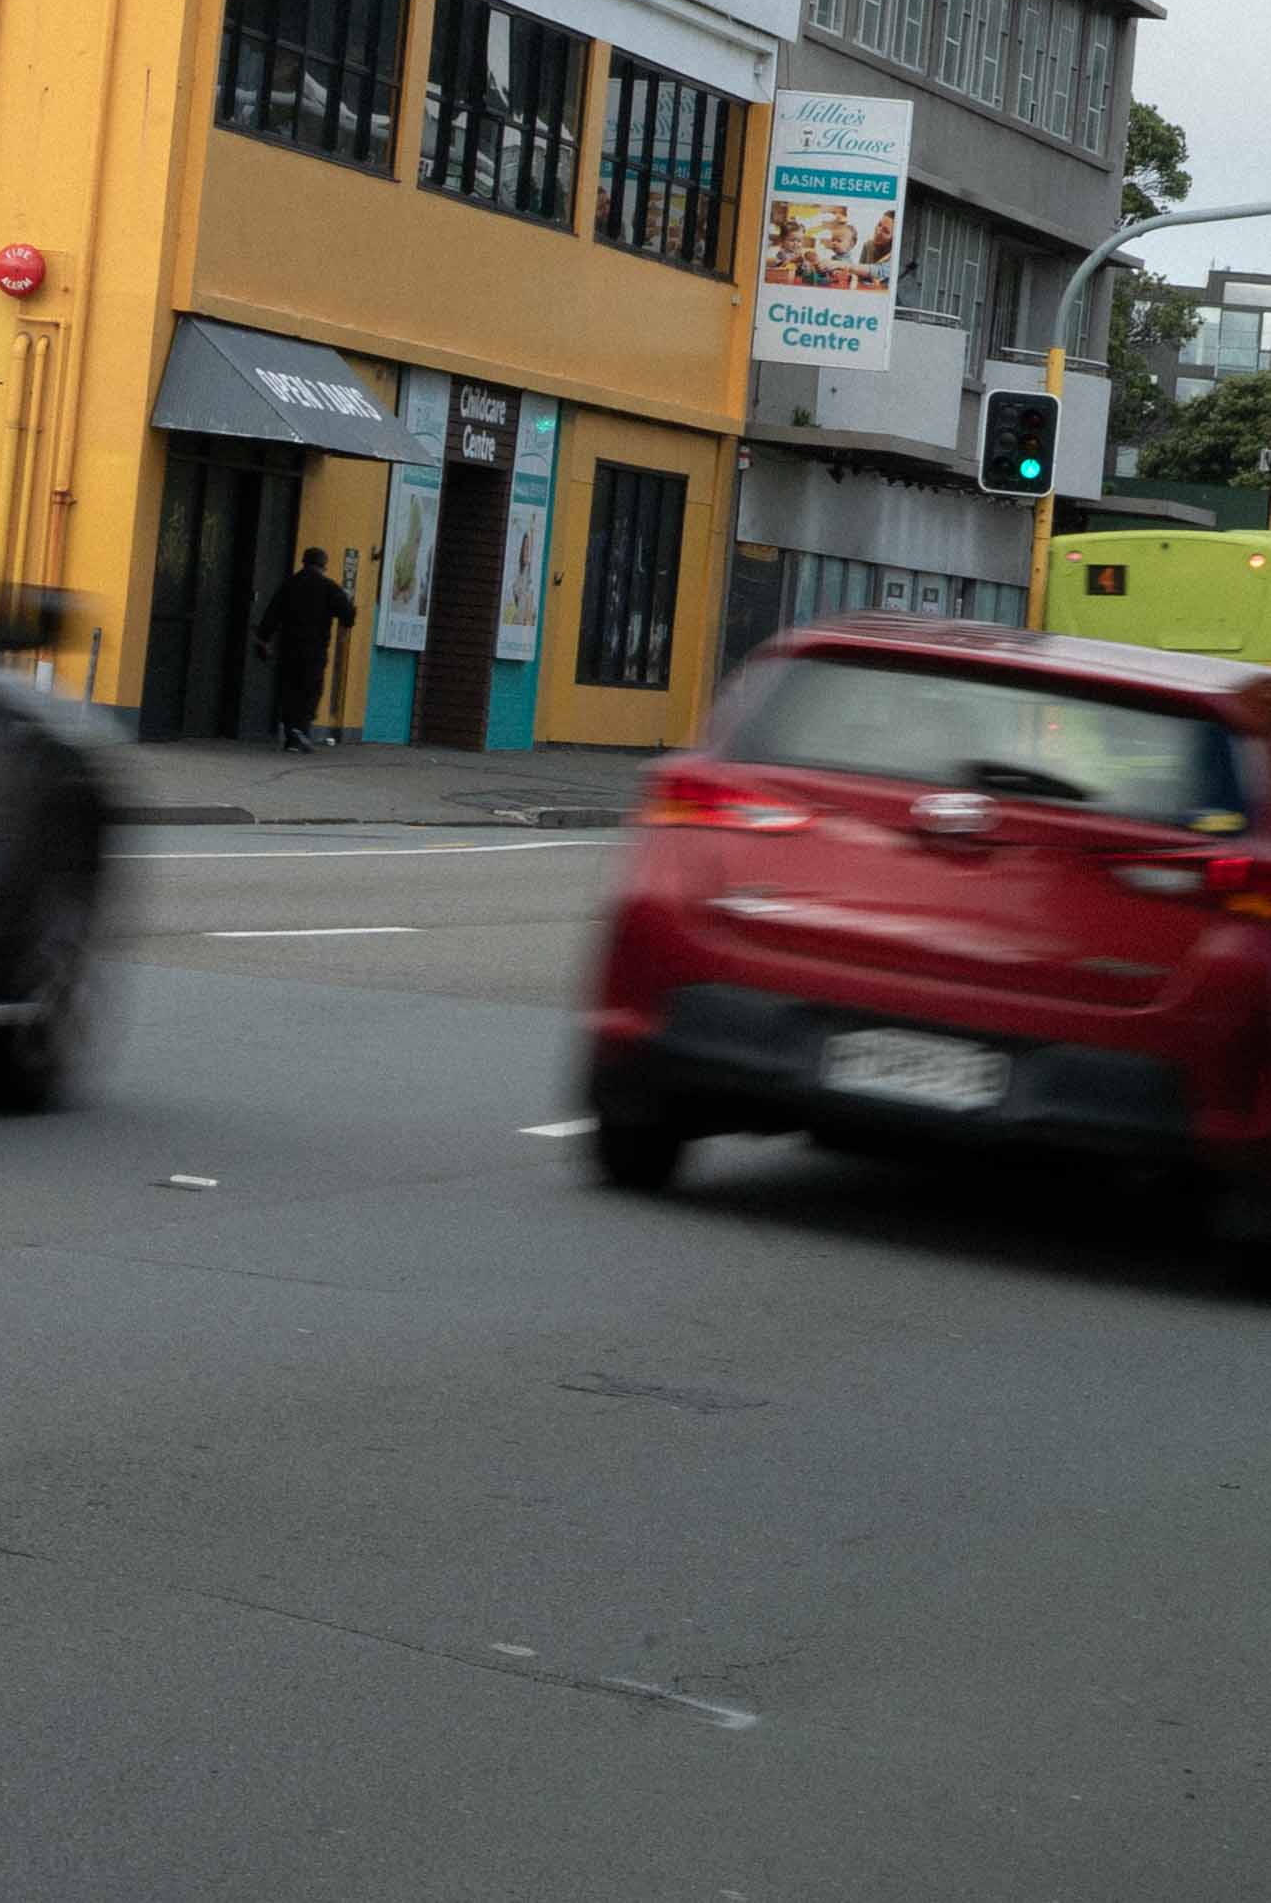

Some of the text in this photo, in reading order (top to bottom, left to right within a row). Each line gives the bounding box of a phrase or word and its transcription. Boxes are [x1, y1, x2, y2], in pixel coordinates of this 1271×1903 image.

[780, 97, 867, 127] Millie's
[816, 127, 896, 154] House
[781, 172, 891, 195] BASIN RESERVE
[4, 247, 33, 260] FIRE
[0, 275, 33, 291] ALARM
[768, 303, 879, 331] Childcare
[782, 327, 861, 352] Centre
[255, 367, 325, 410] OPEN
[316, 380, 383, 422] DAYS
[460, 383, 507, 426] Childcare
[461, 423, 497, 463] Centre
